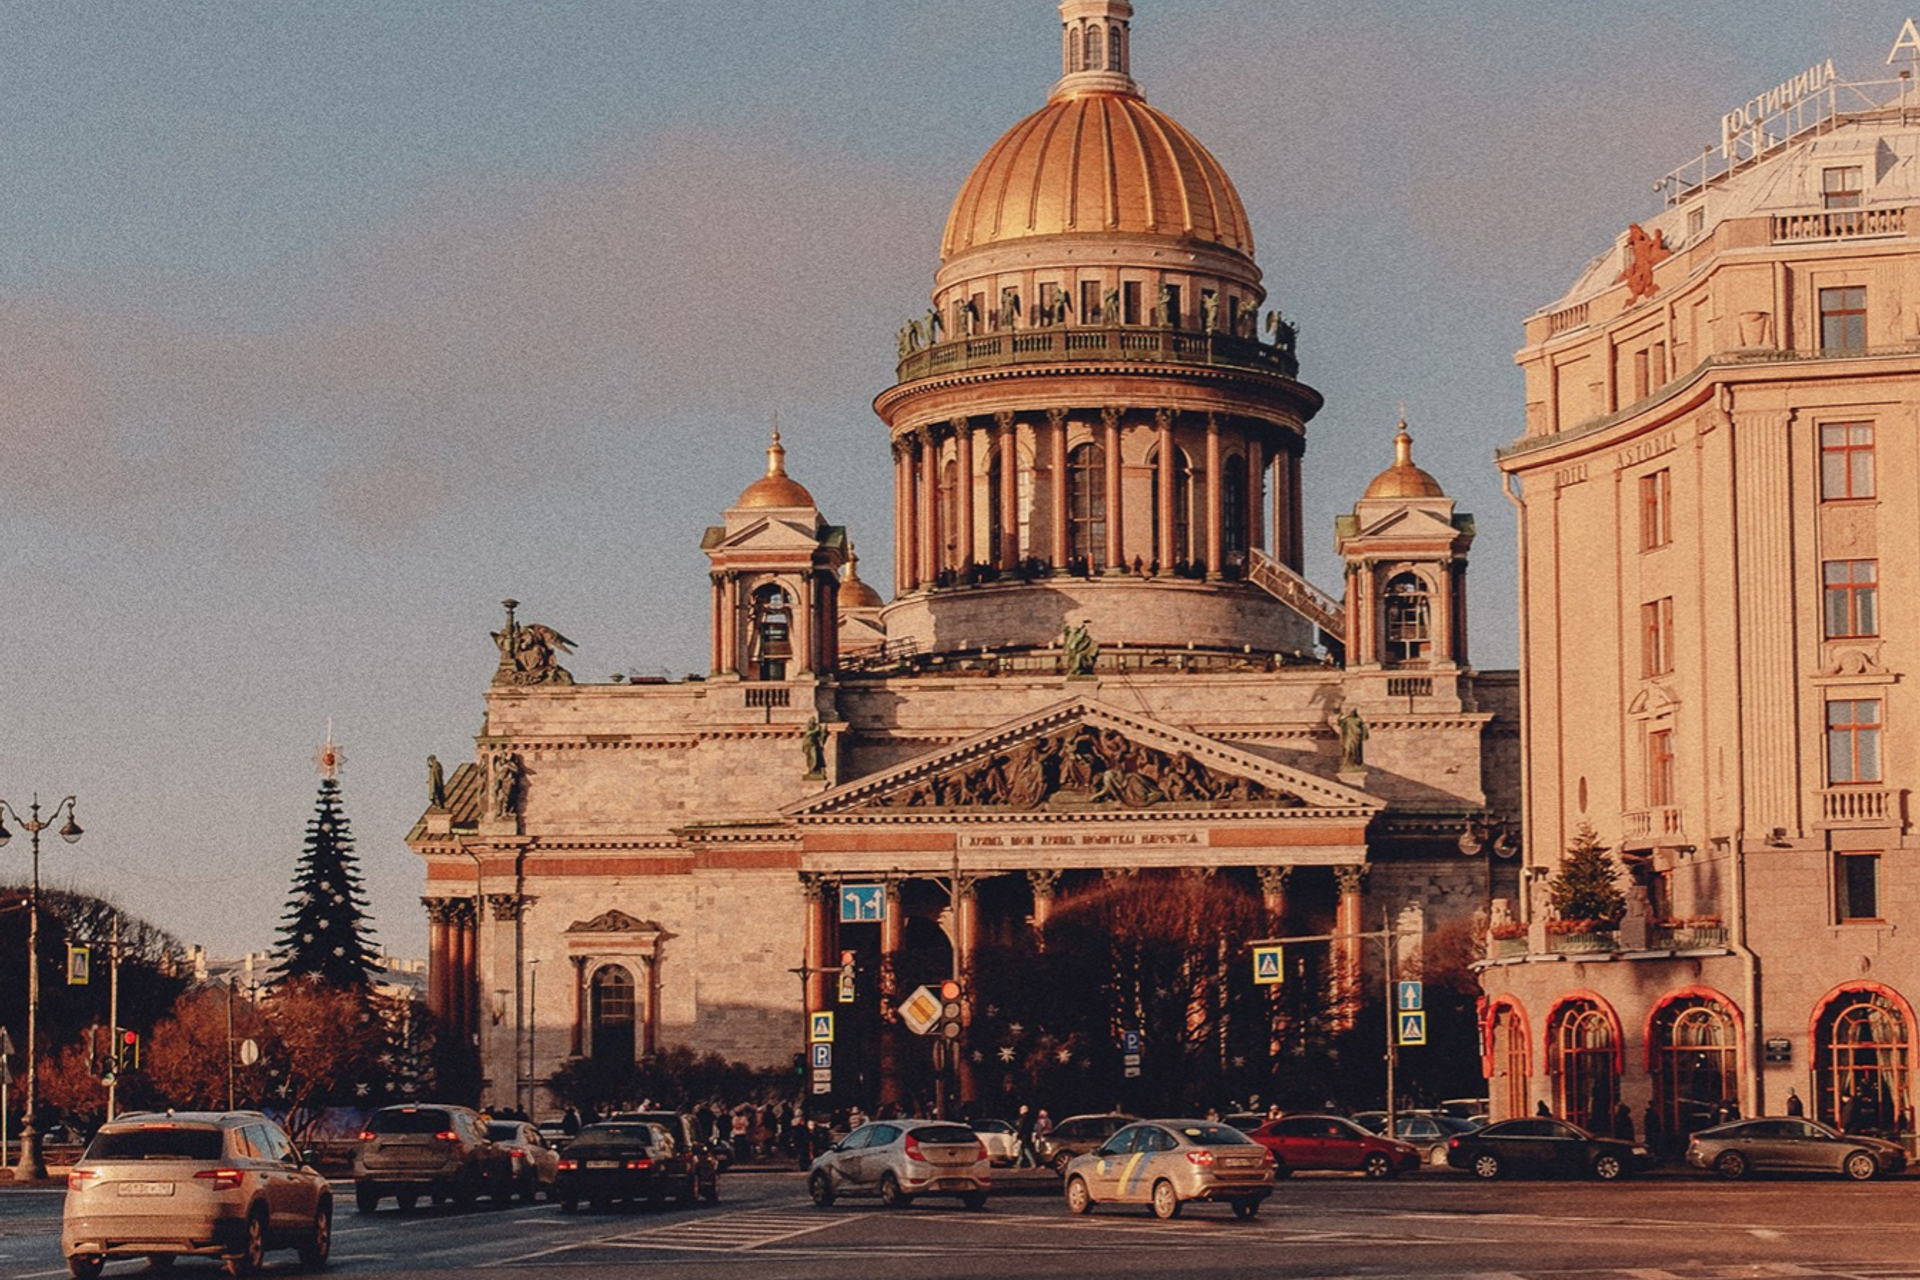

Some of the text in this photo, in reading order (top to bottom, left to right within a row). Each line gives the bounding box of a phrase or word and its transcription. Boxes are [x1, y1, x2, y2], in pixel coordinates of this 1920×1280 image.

[1722, 58, 1835, 158] ГОСТИНИЦА
[1616, 432, 1677, 468] ASTORIA
[817, 1046, 828, 1064] P
